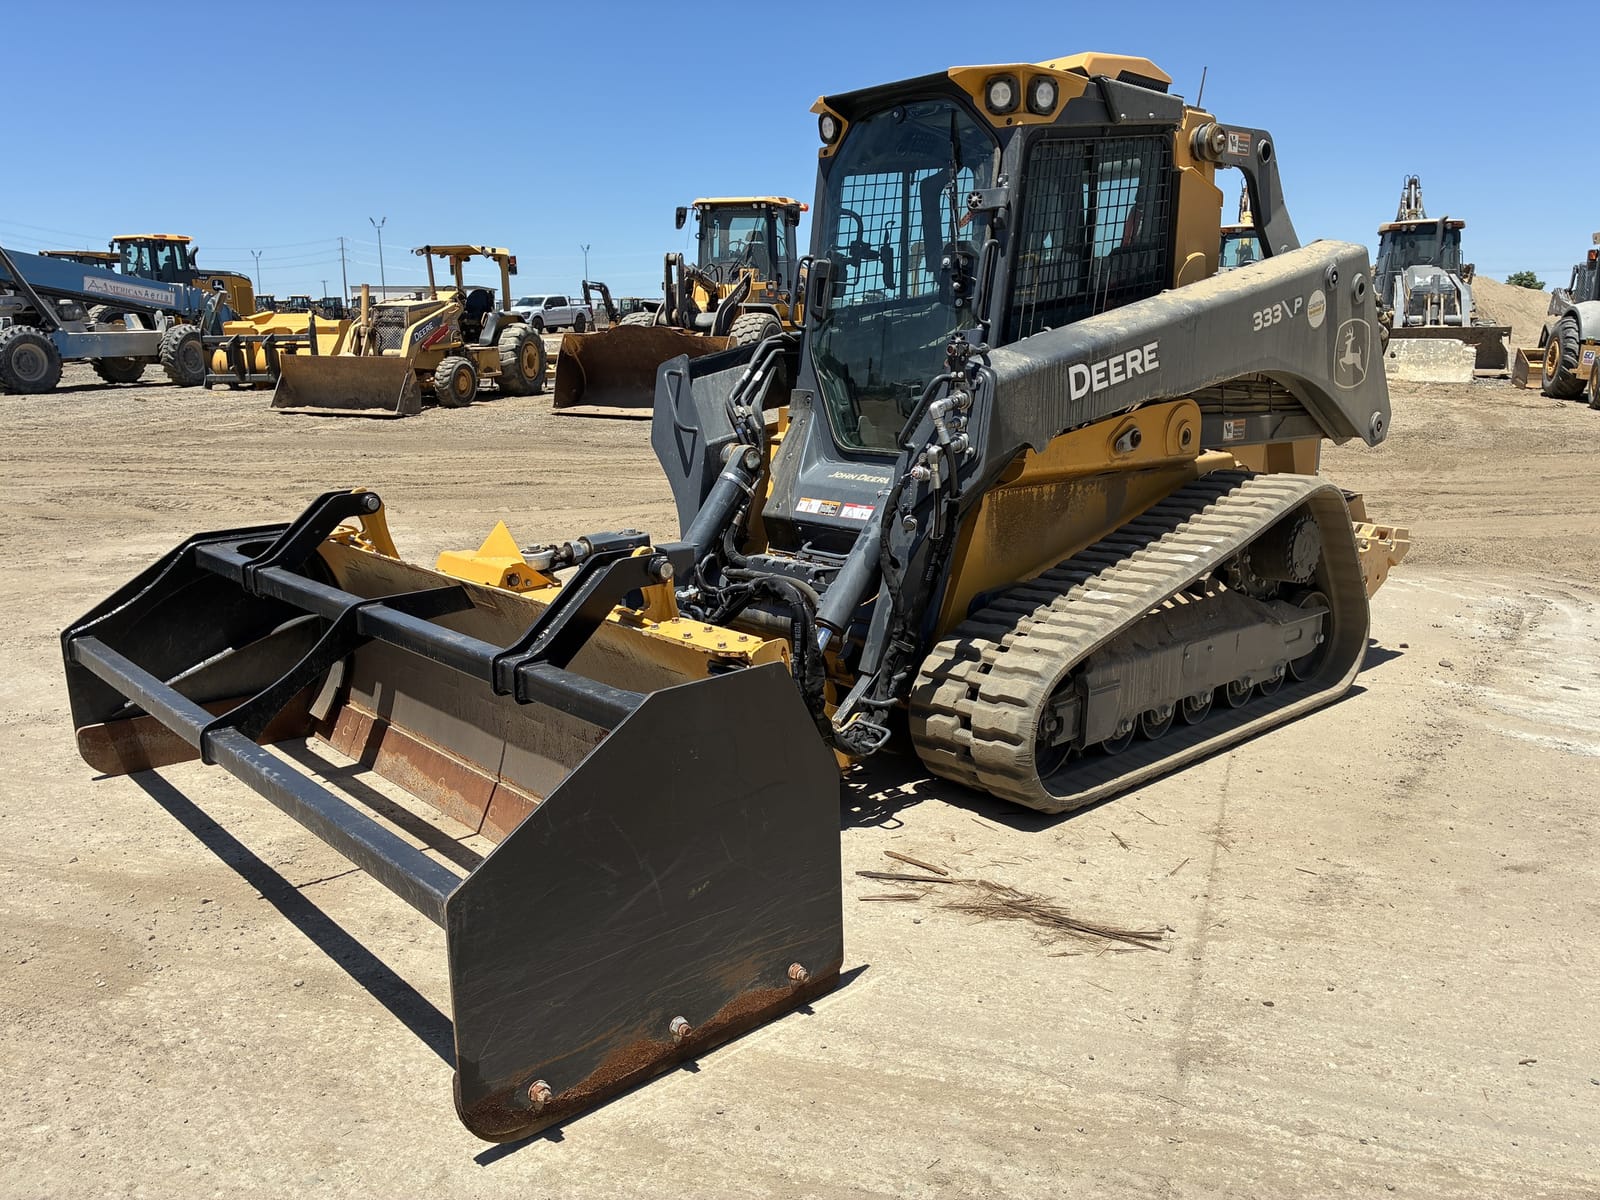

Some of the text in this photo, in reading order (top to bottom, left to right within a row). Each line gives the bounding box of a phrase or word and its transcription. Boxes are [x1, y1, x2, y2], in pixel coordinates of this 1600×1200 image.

[414, 321, 434, 342] DEERE
[1068, 341, 1160, 401] DEERE
[828, 471, 857, 480] JOHN
